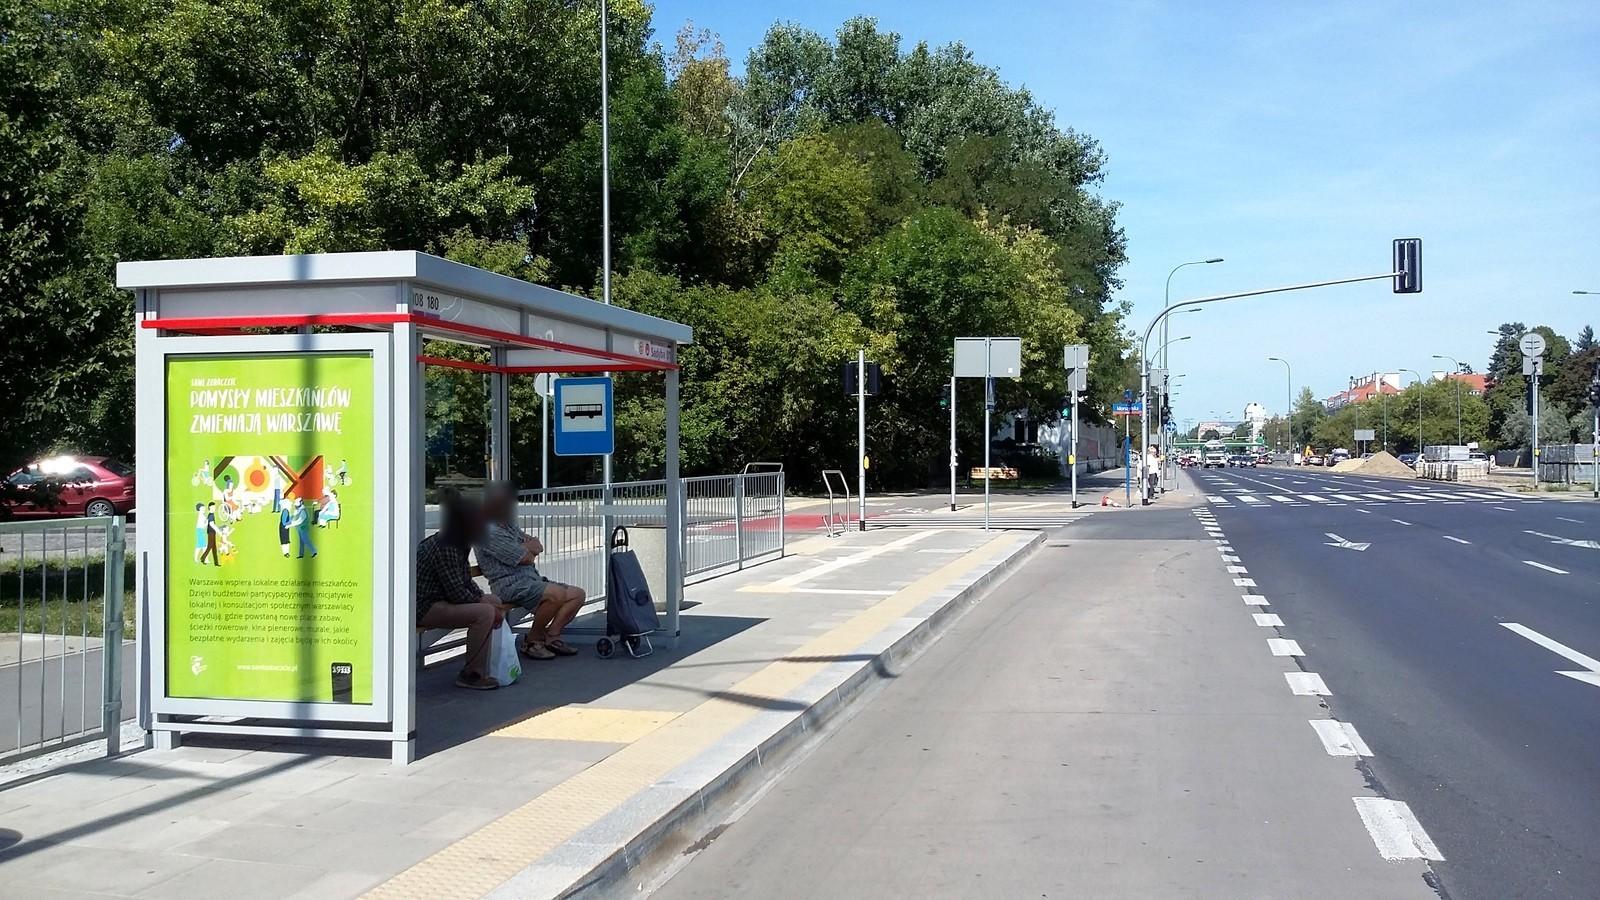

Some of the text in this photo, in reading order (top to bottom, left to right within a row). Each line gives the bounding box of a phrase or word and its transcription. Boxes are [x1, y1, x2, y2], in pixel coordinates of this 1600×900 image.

[427, 295, 440, 310] 180
[190, 386, 352, 408] POMYSŁY MIESZKAŃCÓW
[190, 411, 344, 435] ZMIENIAJĄ WARSZAWĘ
[189, 578, 224, 586] Warszawa
[225, 579, 252, 588] wspiera
[253, 578, 279, 587] lokalne
[189, 588, 211, 598] Dzięki
[212, 590, 249, 598] budżetowi
[189, 600, 217, 610] lokalnej
[222, 601, 269, 610] konsultacjom
[224, 613, 243, 622] gdzie
[189, 634, 225, 643] bezpłatne
[226, 635, 265, 644] wydarzenia
